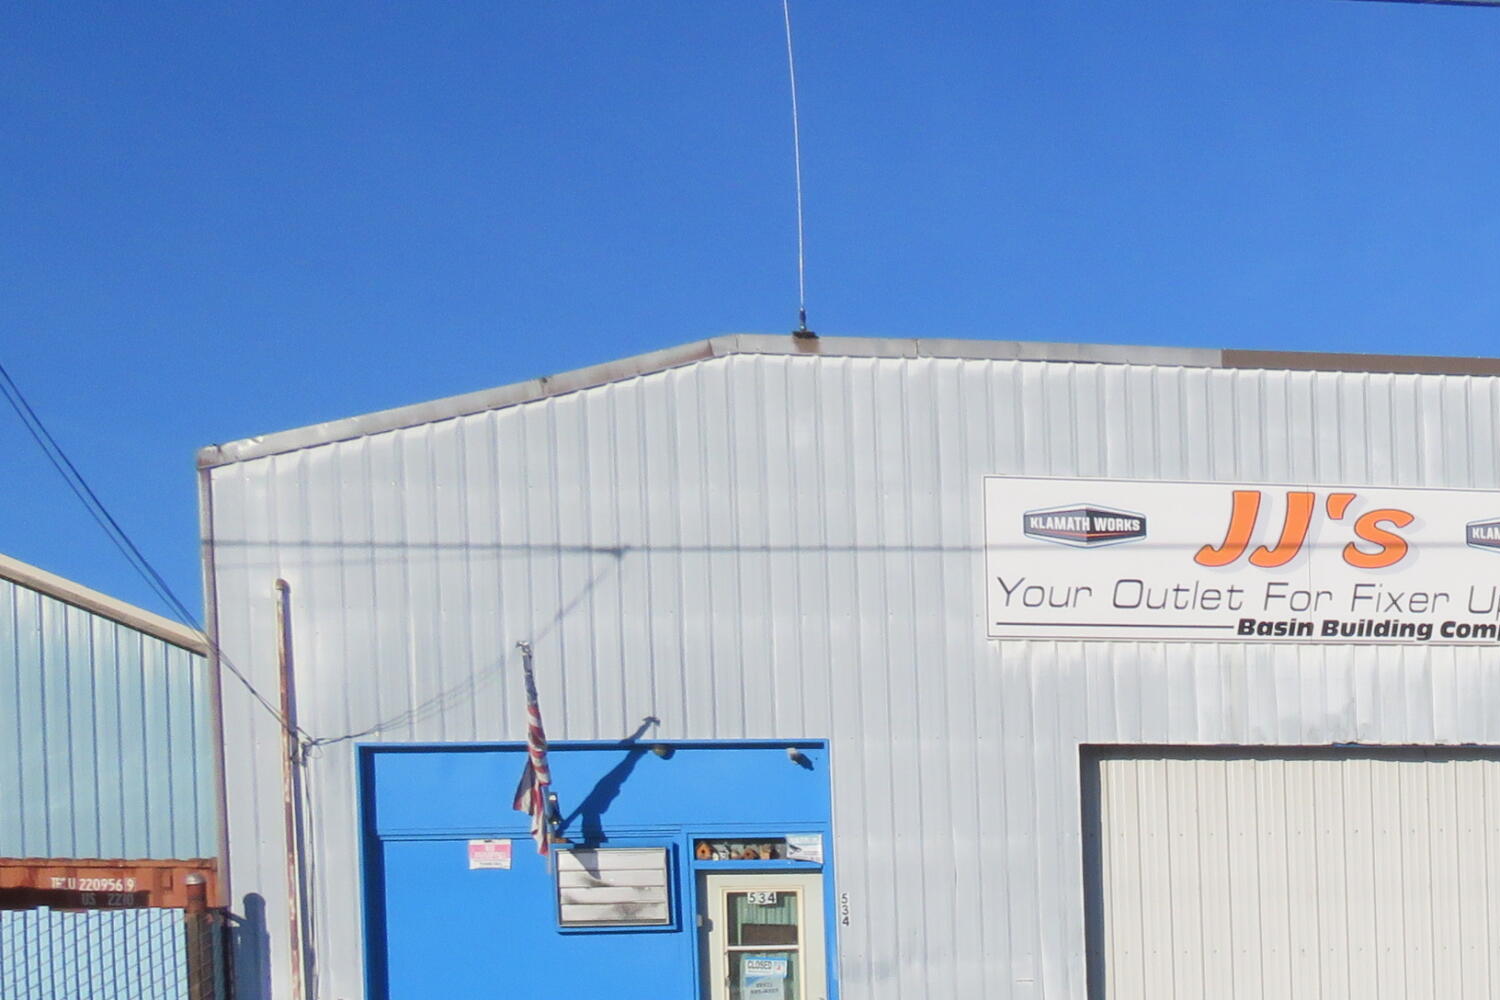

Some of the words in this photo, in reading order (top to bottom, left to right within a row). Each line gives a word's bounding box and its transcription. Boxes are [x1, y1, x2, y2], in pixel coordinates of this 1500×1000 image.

[1030, 516, 1090, 532] KLAMATH
[1094, 516, 1141, 532] WORKS
[1194, 490, 1415, 569] JJ's
[997, 576, 1093, 608] Your
[1112, 578, 1244, 611] Outlet
[1263, 581, 1333, 612] For
[1350, 583, 1450, 614] Fixer
[1237, 618, 1314, 637] Basin
[1321, 619, 1433, 642] Building
[79, 878, 123, 892] 220956
[749, 891, 776, 904] 534
[841, 892, 849, 926] 534
[748, 960, 772, 969] CLOSED
